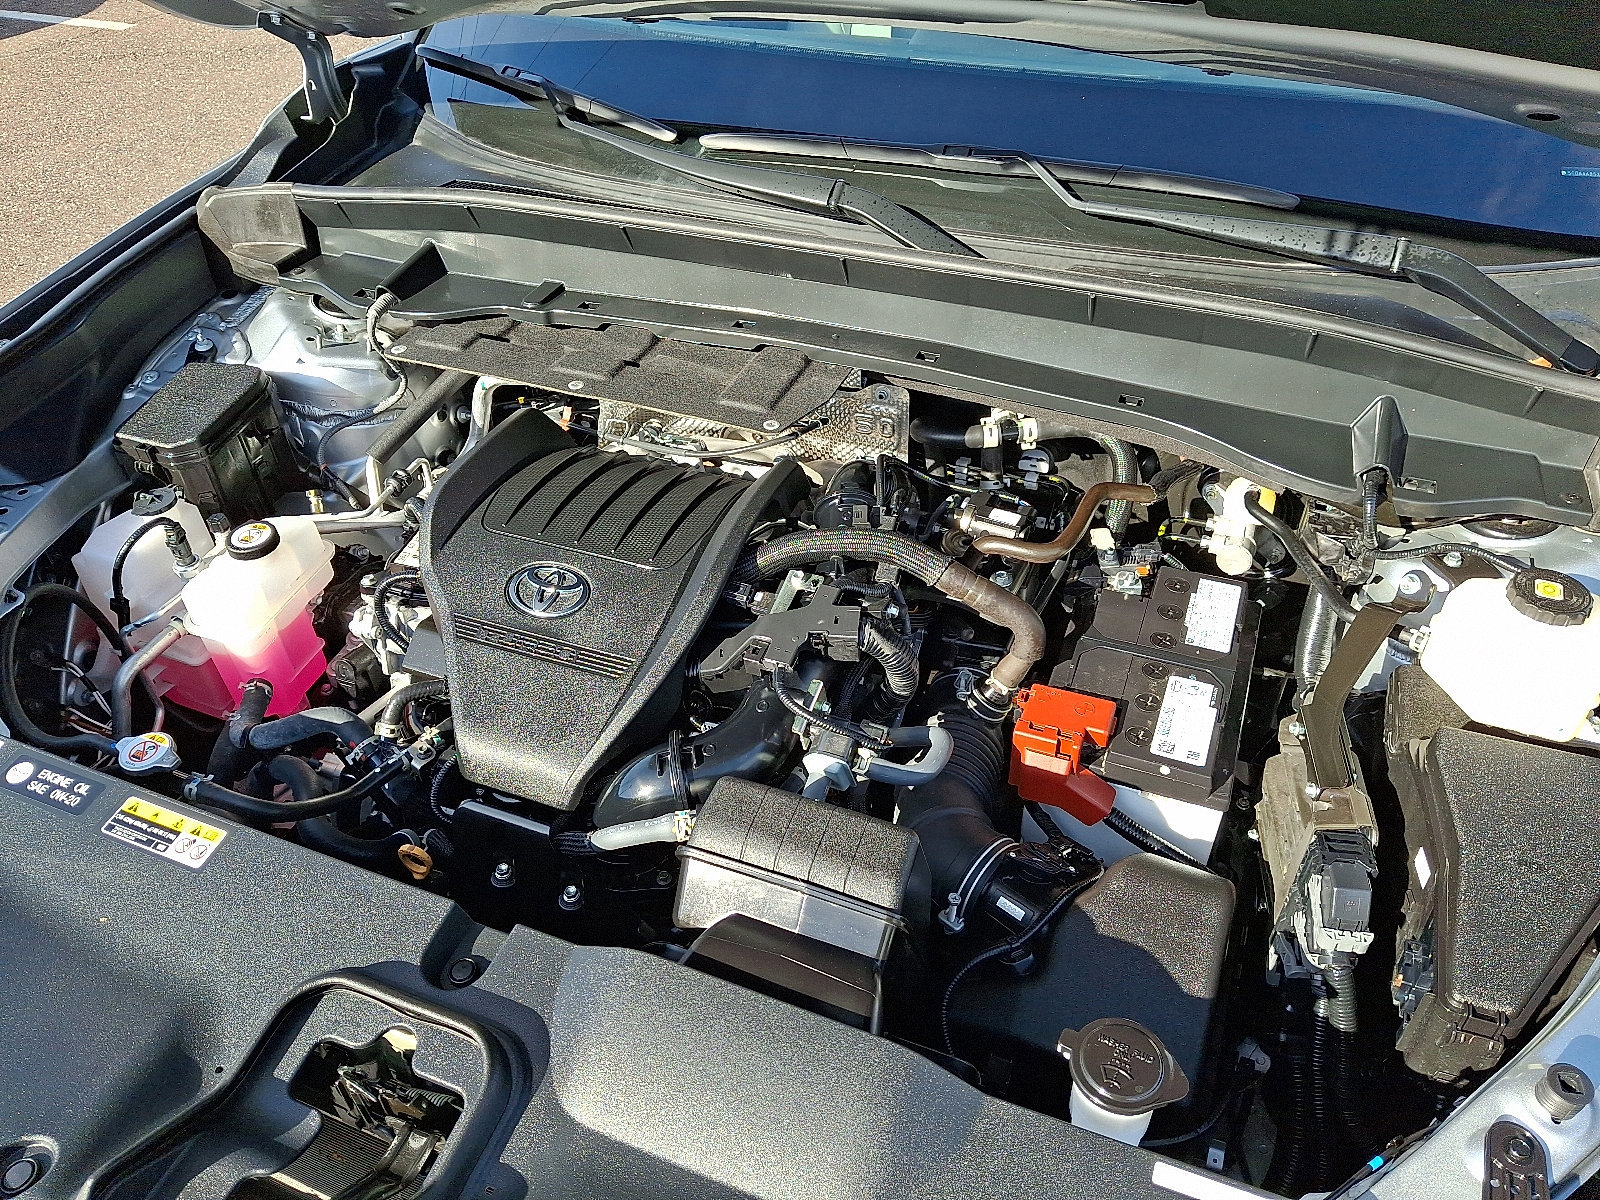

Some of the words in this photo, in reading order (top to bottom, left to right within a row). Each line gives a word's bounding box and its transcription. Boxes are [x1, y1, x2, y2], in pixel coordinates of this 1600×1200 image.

[26, 780, 50, 795] SAE
[49, 789, 81, 807] 0W-20
[36, 768, 74, 788] ENGINE
[73, 782, 91, 796] OIL
